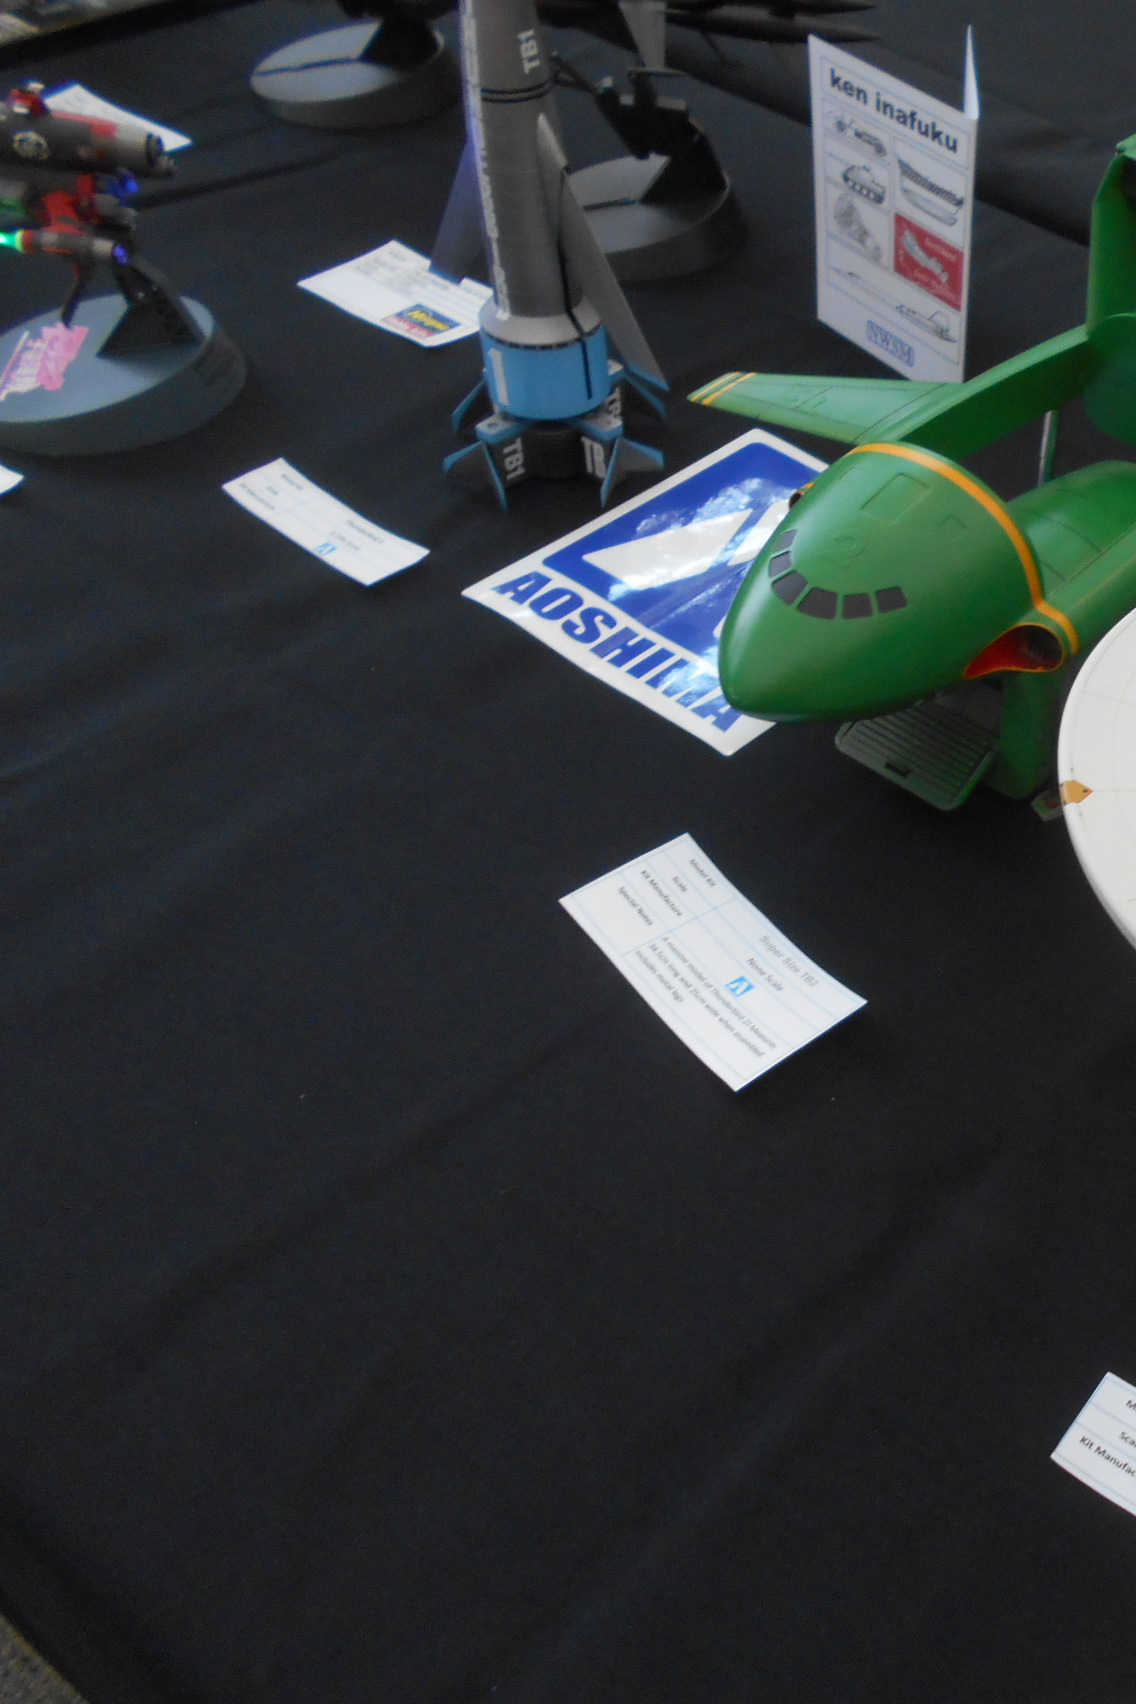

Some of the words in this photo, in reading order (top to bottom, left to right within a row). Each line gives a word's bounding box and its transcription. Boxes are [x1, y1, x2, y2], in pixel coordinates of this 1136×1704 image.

[518, 29, 540, 74] TB1
[830, 67, 868, 105] ken
[875, 92, 958, 153] inafuku
[503, 437, 525, 481] TB1
[491, 570, 744, 733] AOSHIMA
[619, 886, 640, 908] Special
[636, 907, 654, 926] Notes
[649, 879, 682, 917] Manufacture
[746, 957, 767, 976] None
[766, 974, 783, 991] Scale
[760, 935, 784, 957] Super
[783, 956, 801, 973] Size
[1079, 1435, 1094, 1449] Kit
